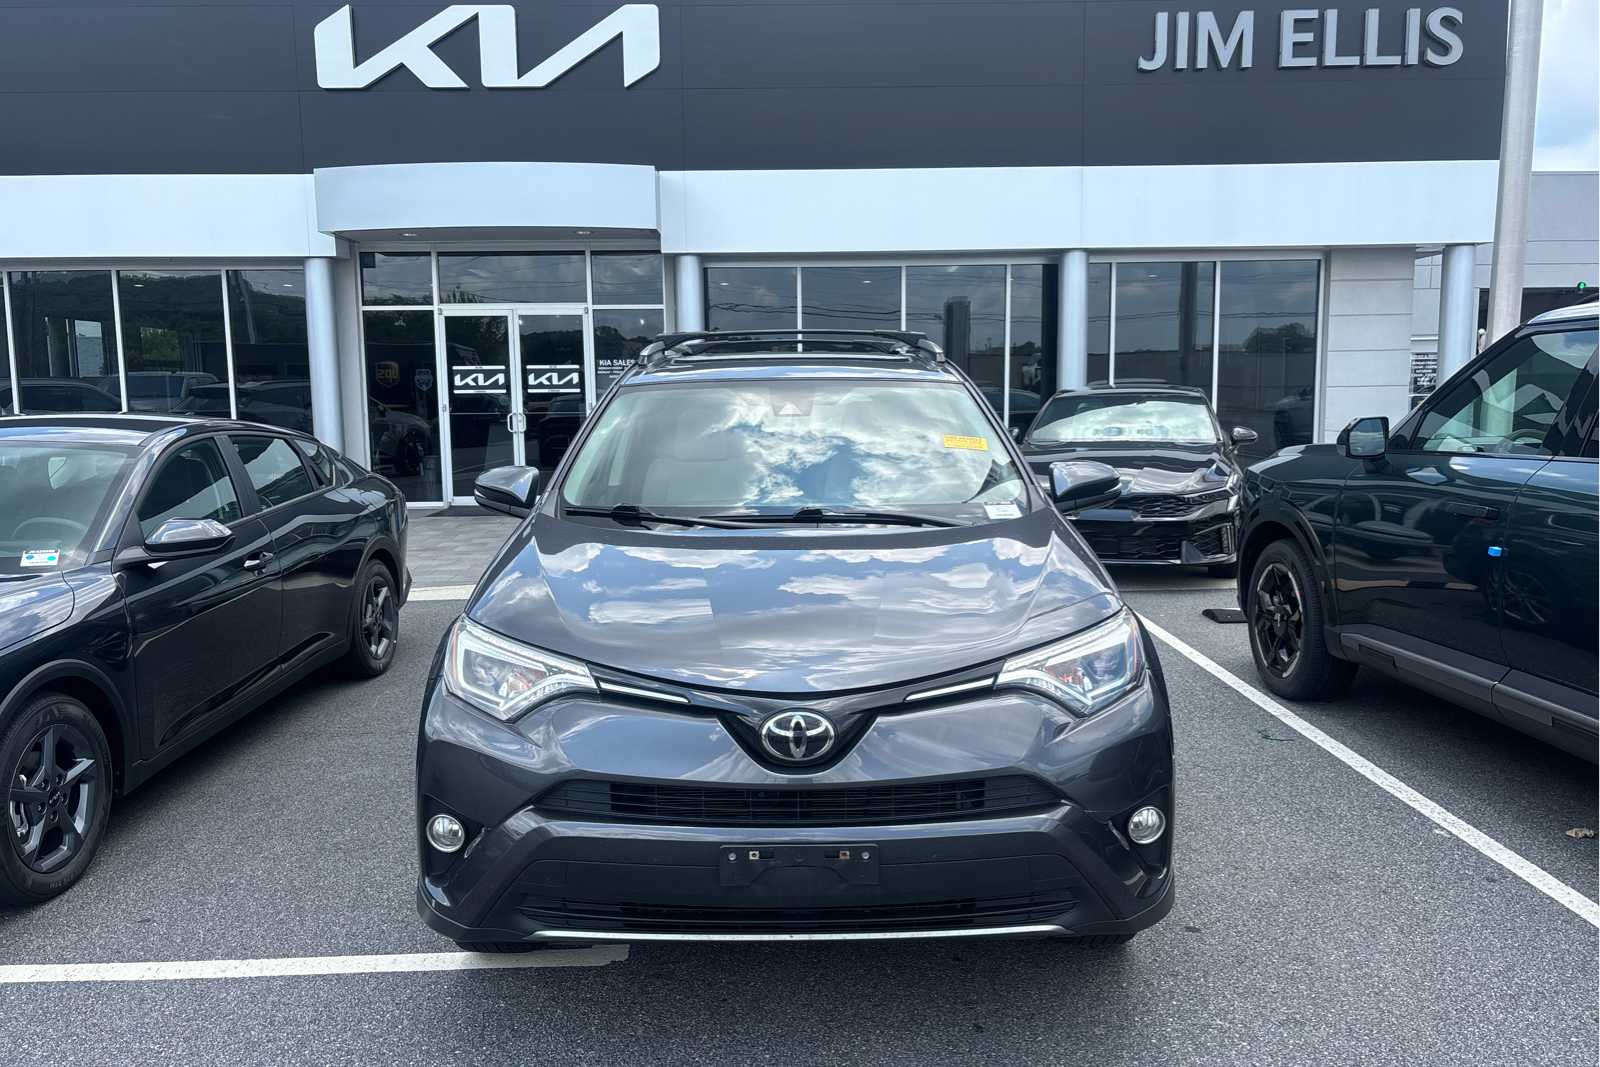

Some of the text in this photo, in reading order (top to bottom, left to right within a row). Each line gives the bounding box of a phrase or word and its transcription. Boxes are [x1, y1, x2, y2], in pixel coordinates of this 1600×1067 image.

[314, 4, 660, 89] KIA
[1137, 7, 1464, 71] JIM ELLIS
[454, 373, 505, 386] KIA
[528, 372, 579, 385] KIA
